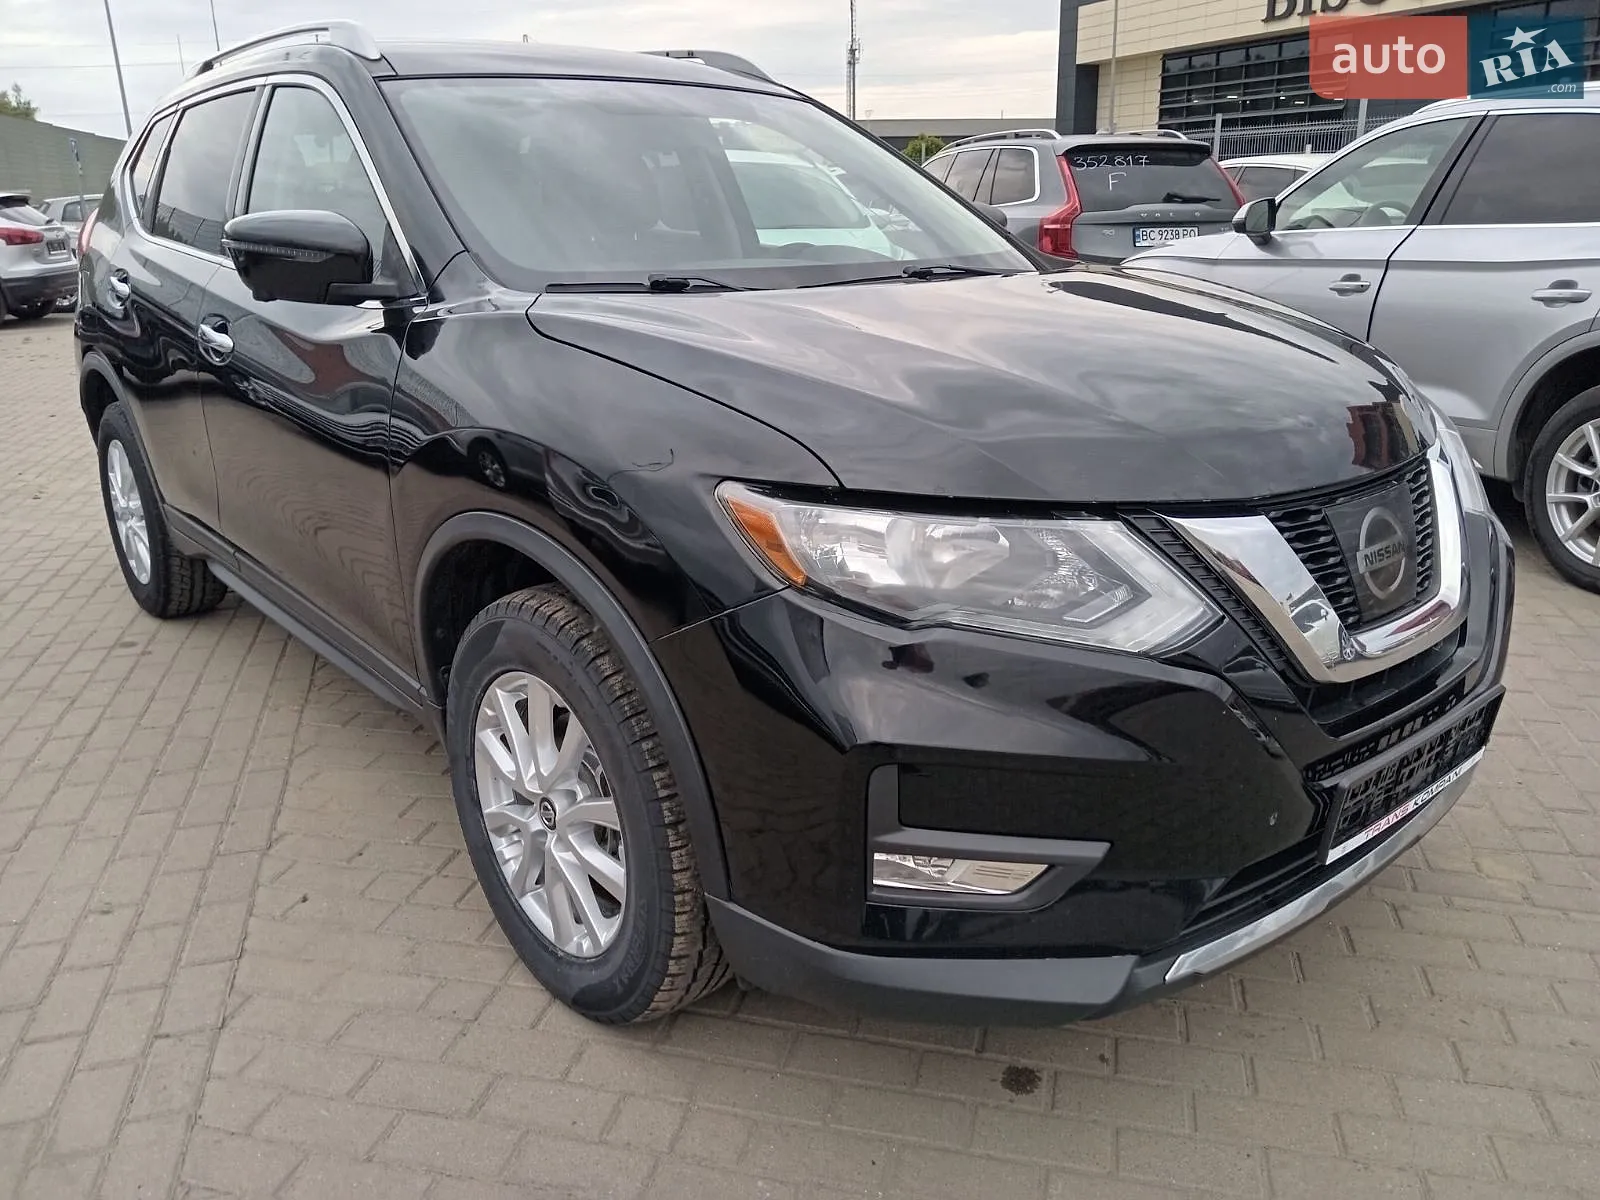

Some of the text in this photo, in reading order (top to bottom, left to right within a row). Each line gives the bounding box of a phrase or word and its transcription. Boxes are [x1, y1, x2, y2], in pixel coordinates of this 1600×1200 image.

[1074, 154, 1150, 171] 352817
[1108, 172, 1127, 191] F
[1141, 229, 1156, 241] BC
[1158, 229, 1180, 241] 9238
[1363, 542, 1406, 568] NISSAN
[1364, 803, 1411, 840] TRANS
